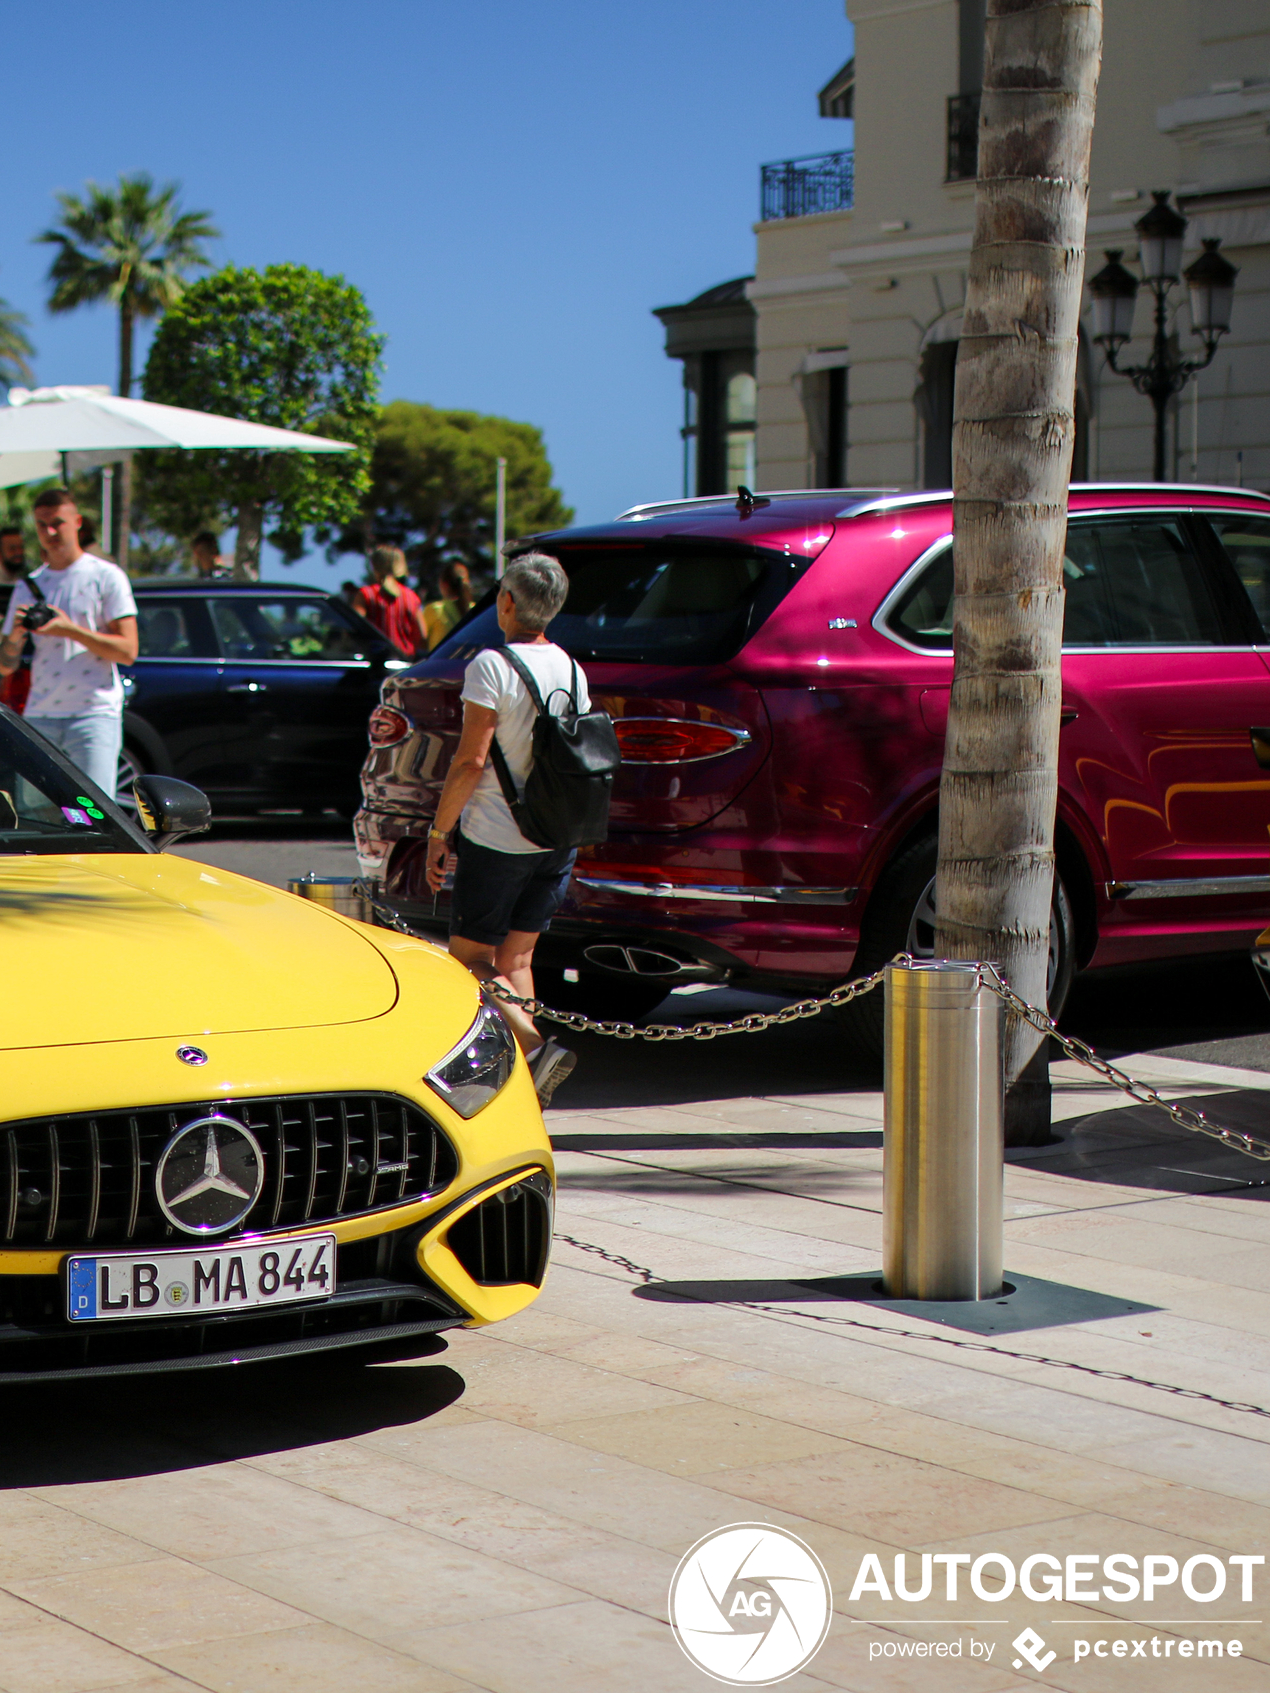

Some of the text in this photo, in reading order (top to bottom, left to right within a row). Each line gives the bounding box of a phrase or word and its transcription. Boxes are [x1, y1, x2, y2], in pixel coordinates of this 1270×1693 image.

[100, 1244, 330, 1311] LB MA 844
[78, 1295, 89, 1309] D
